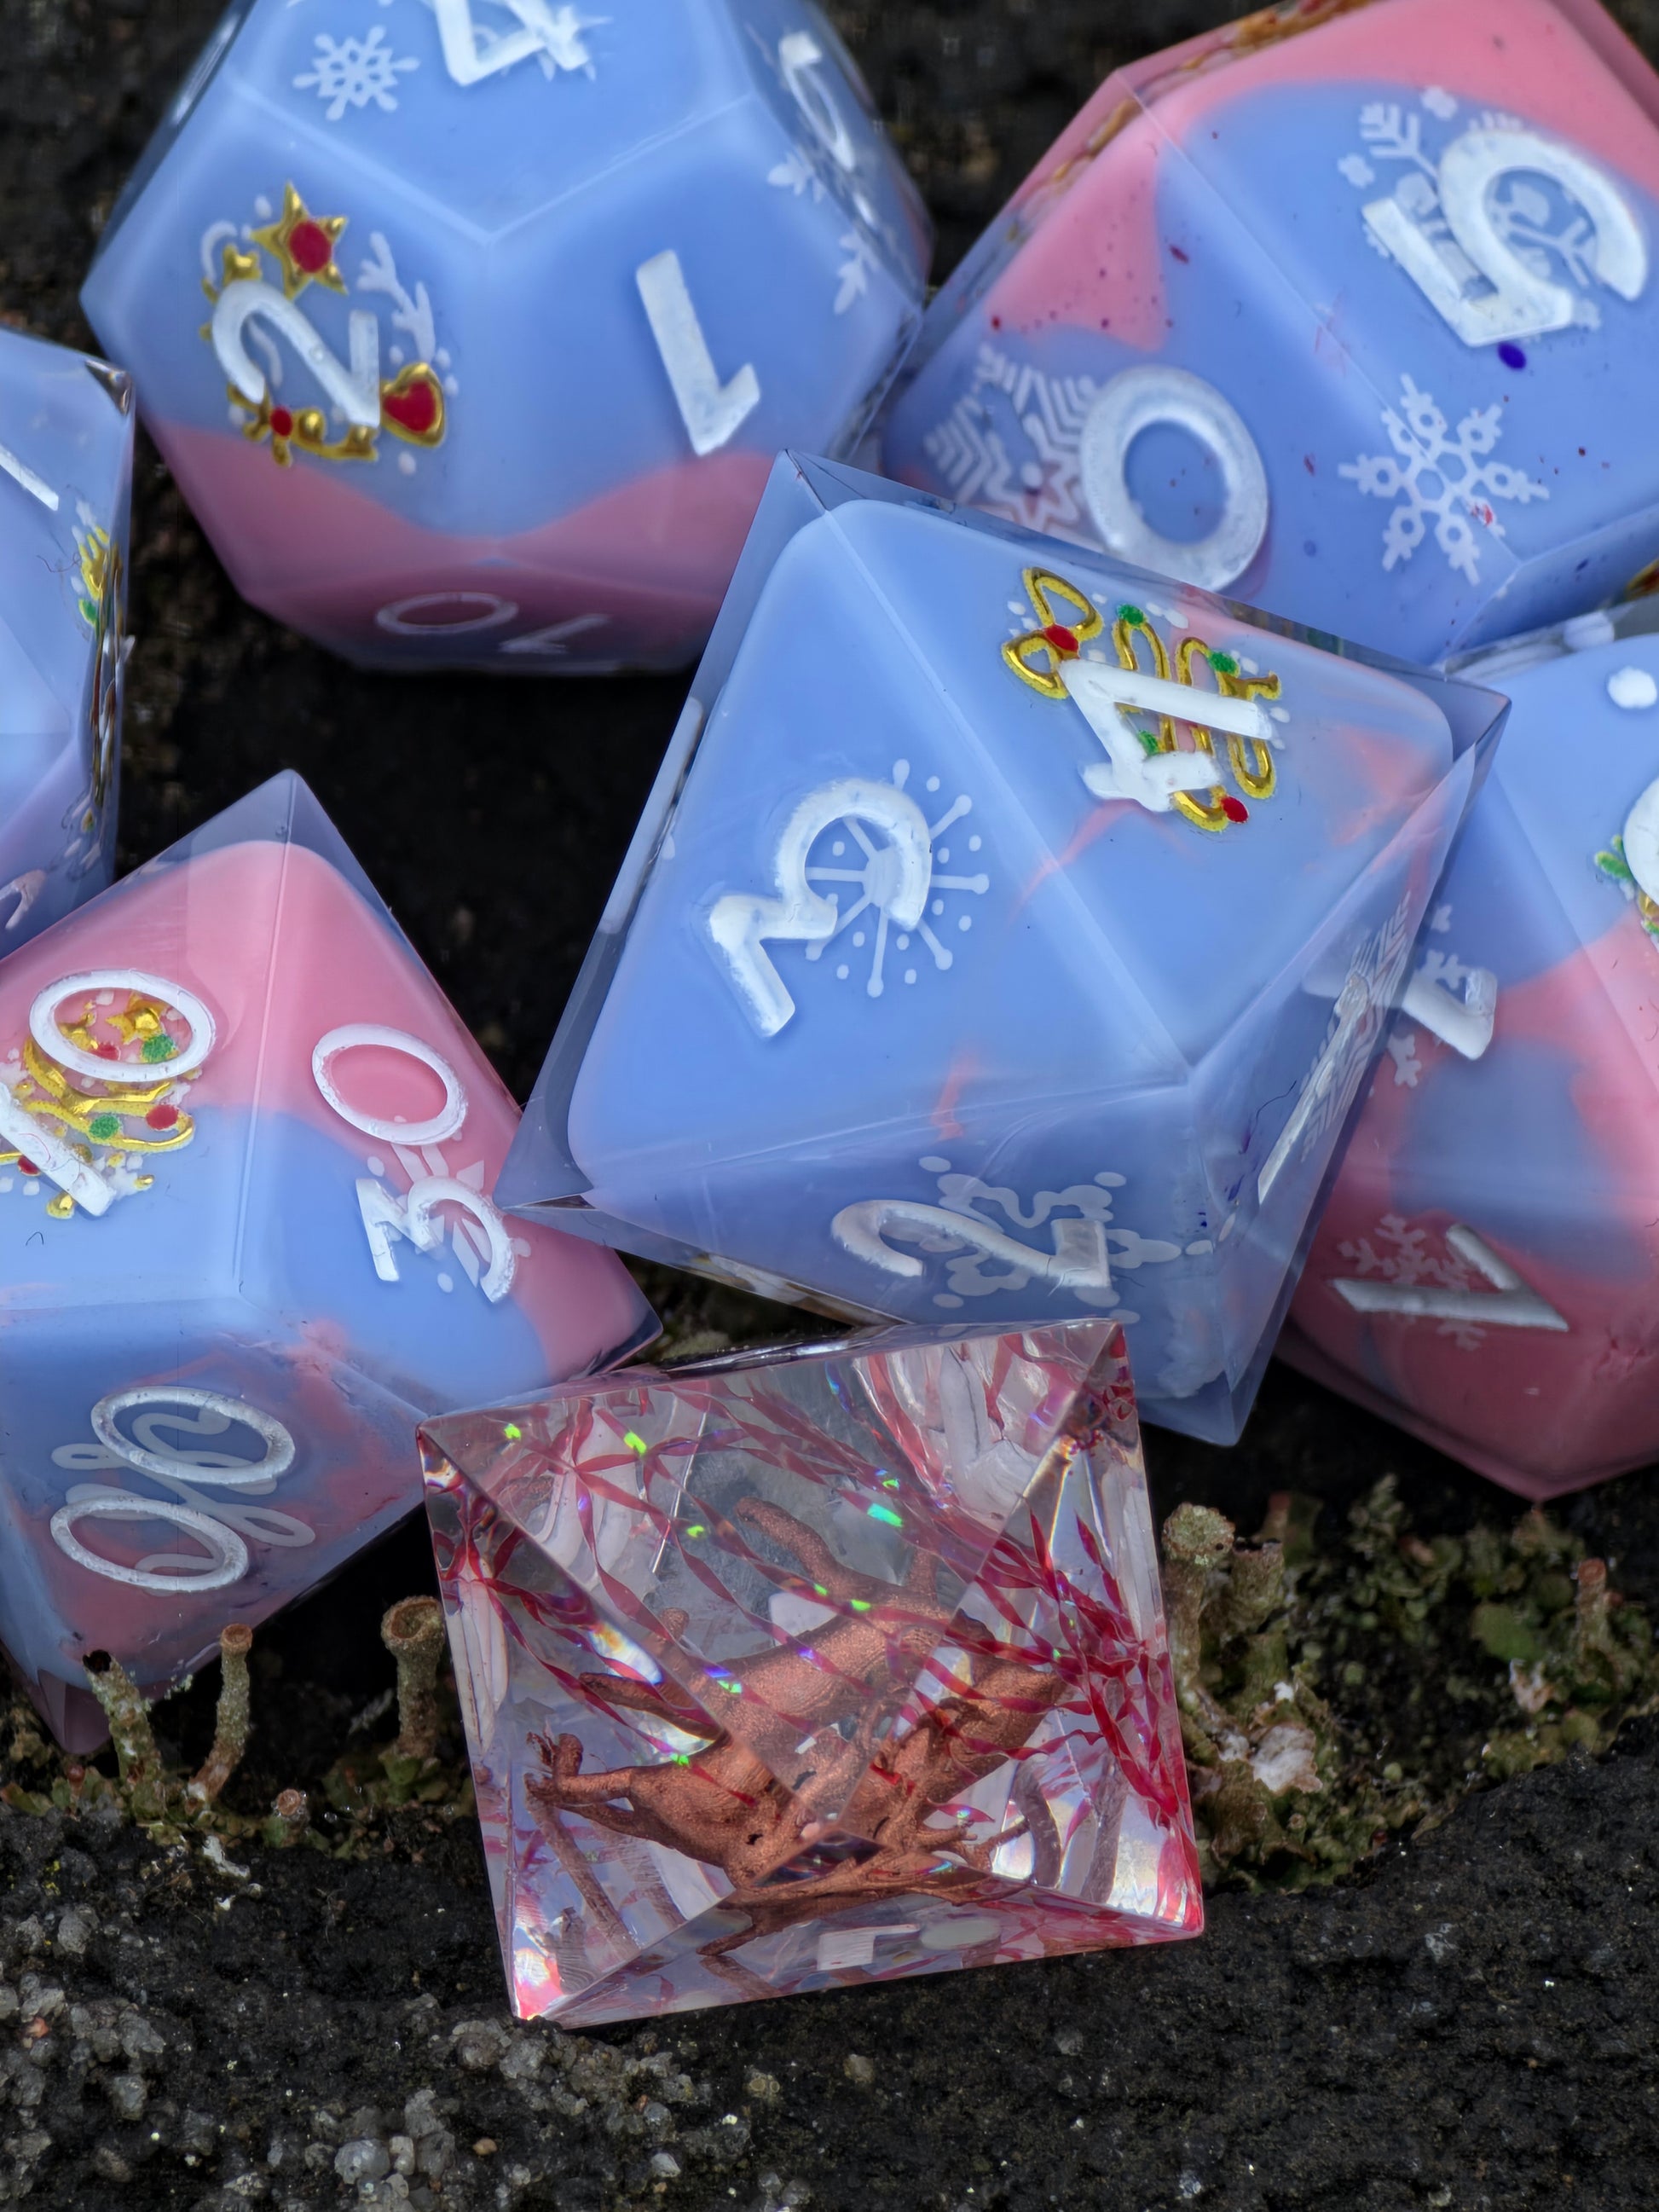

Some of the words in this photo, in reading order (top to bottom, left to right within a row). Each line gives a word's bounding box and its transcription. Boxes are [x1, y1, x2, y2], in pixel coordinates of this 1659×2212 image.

[1363, 130, 1647, 347] 5
[211, 281, 380, 427] 2
[636, 250, 760, 457] 1
[1058, 658, 1272, 812] 4
[708, 779, 931, 1038] 3
[313, 1023, 516, 1303] 30
[832, 1199, 1111, 1288] 2
[51, 1386, 295, 1593] 00
